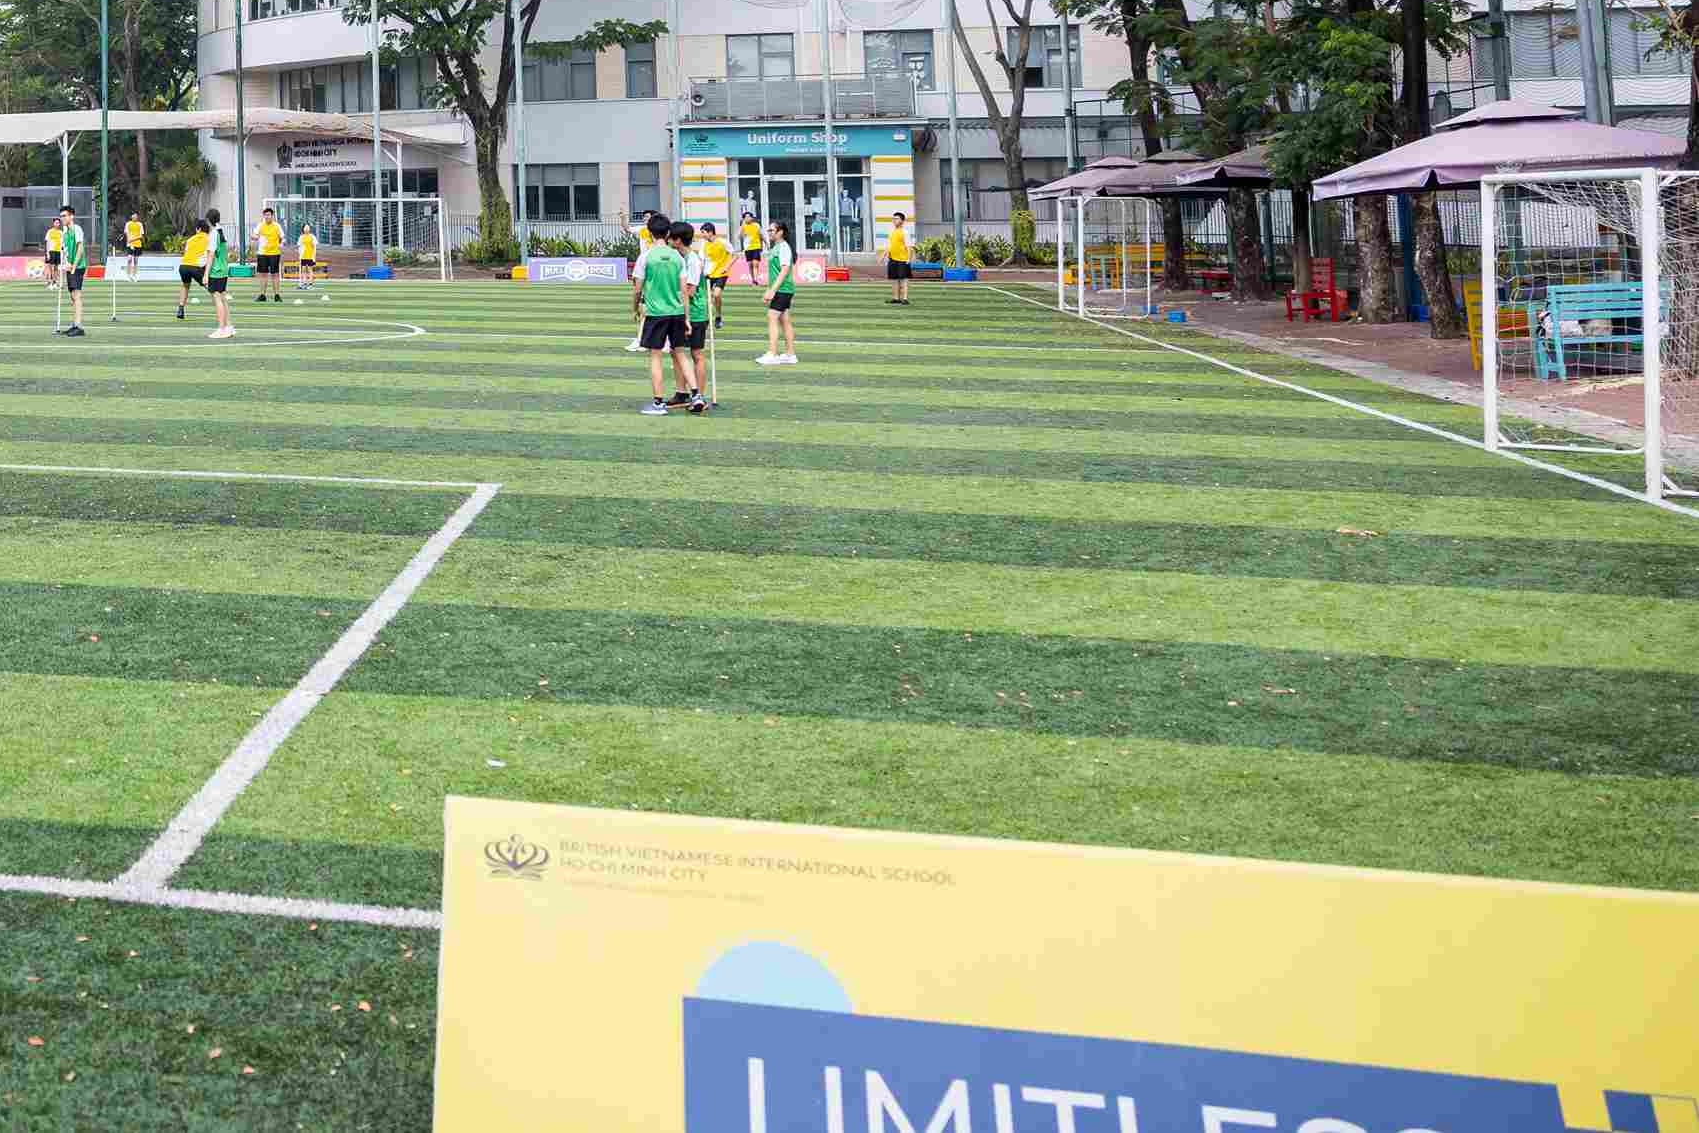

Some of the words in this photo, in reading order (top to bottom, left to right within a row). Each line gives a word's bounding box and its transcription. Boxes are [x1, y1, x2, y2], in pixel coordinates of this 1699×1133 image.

[748, 132, 807, 145] Uniform
[811, 131, 847, 146] Shop
[559, 841, 622, 859] BRITISH
[627, 846, 734, 868] VIETNAMESE
[737, 856, 877, 880] INTERNATIONAL
[882, 867, 957, 886] SCHOOL
[559, 857, 584, 871] HO
[587, 859, 619, 875] CHI
[620, 863, 667, 878] MINH
[669, 867, 709, 883] CITY
